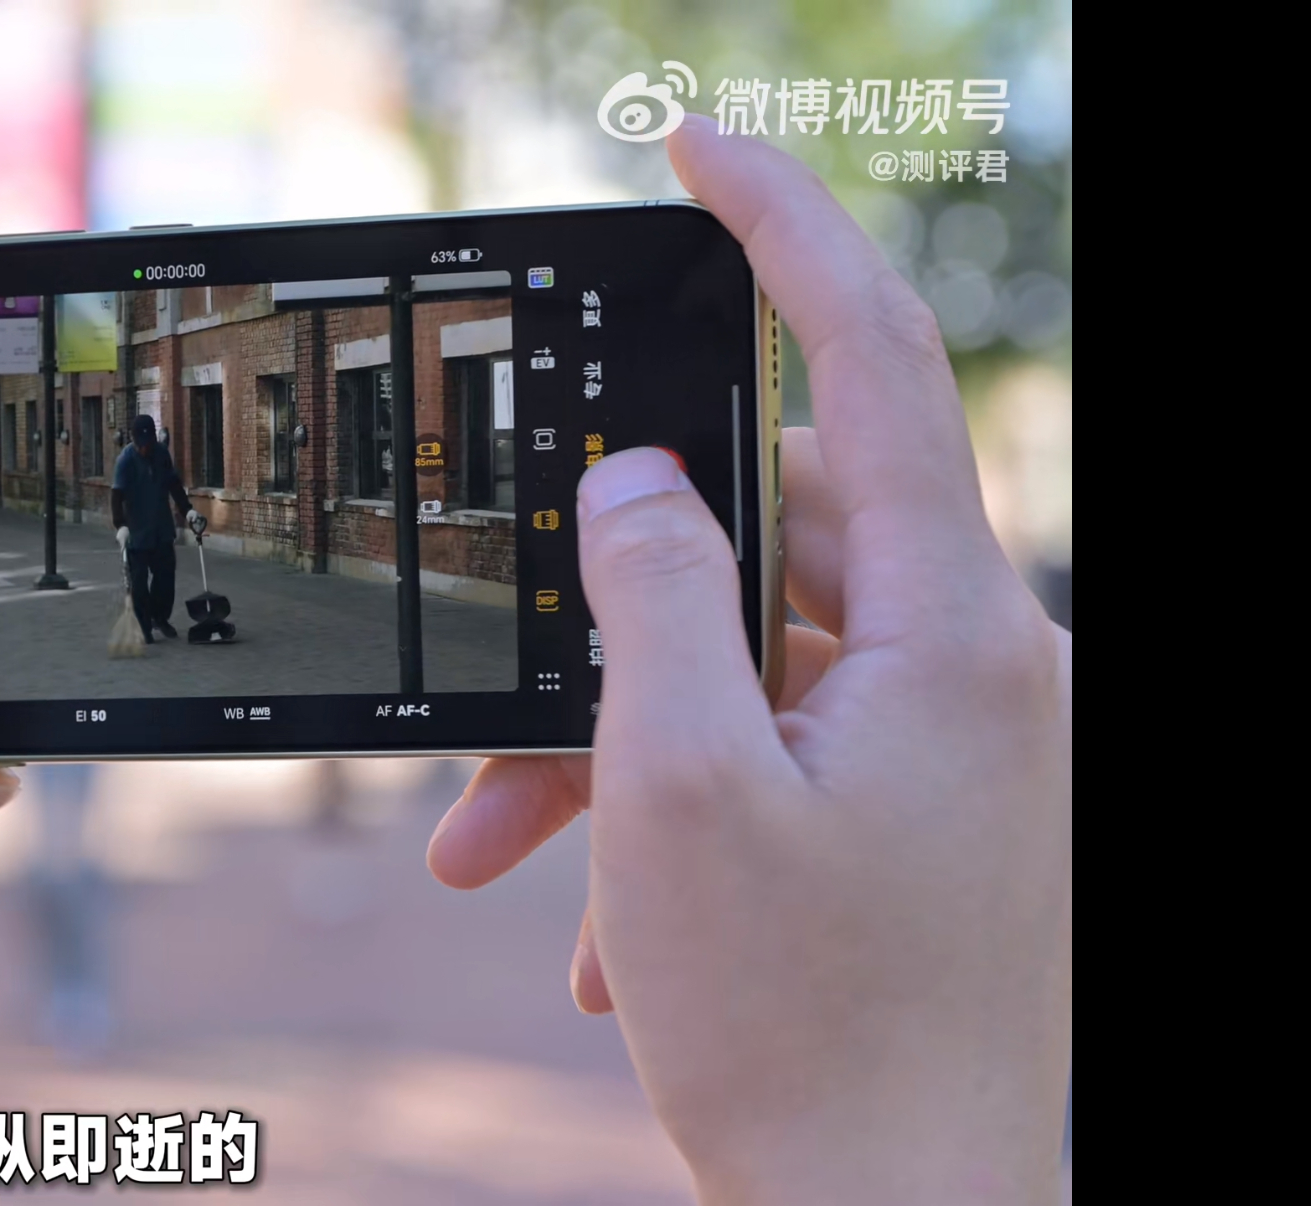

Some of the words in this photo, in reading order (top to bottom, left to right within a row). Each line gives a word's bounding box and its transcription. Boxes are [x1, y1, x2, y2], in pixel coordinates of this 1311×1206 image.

[430, 251, 456, 264] 63%
[145, 263, 205, 280] 00:00:00
[533, 273, 549, 284] LUT
[582, 290, 602, 328] 更多
[535, 358, 551, 369] EV
[583, 361, 602, 400] 专业
[414, 458, 444, 467] 85mm
[416, 515, 445, 525] 24mm
[536, 595, 558, 606] DISP
[75, 710, 88, 723] EI
[90, 709, 107, 723] 50
[224, 706, 244, 721] WB
[249, 706, 271, 717] AWB
[375, 706, 392, 718] AF
[396, 704, 431, 718] AF-C
